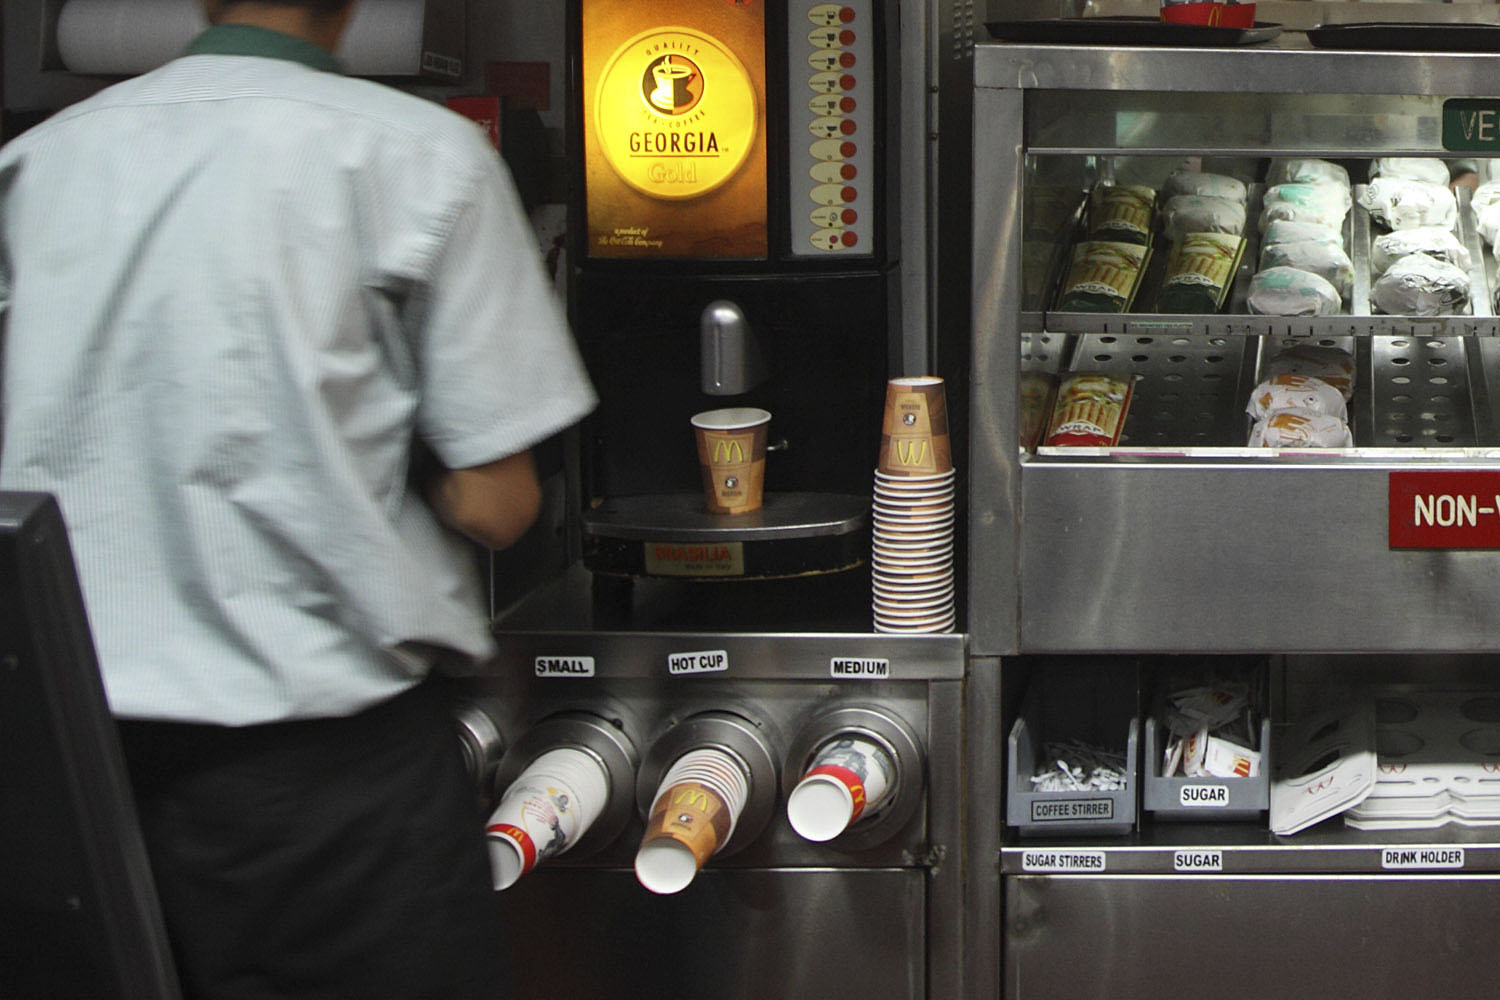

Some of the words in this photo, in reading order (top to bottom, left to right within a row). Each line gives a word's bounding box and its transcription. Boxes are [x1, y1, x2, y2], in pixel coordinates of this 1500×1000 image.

[629, 132, 719, 153] GEORGIA
[647, 161, 698, 184] Gold
[537, 659, 588, 674] SMALL
[671, 656, 697, 671] HOT
[699, 654, 725, 670] CUP
[833, 660, 887, 675] MEDIUM
[1182, 788, 1226, 802] SUGAR
[1035, 803, 1069, 817] COFFEE
[1071, 801, 1110, 817] STIRRER
[1025, 854, 1057, 868] SUGAR
[1058, 854, 1103, 869] STIRRERS
[1175, 854, 1221, 868] SUGAR
[1385, 850, 1418, 865] DRINK
[1420, 850, 1462, 864] HOLDER
